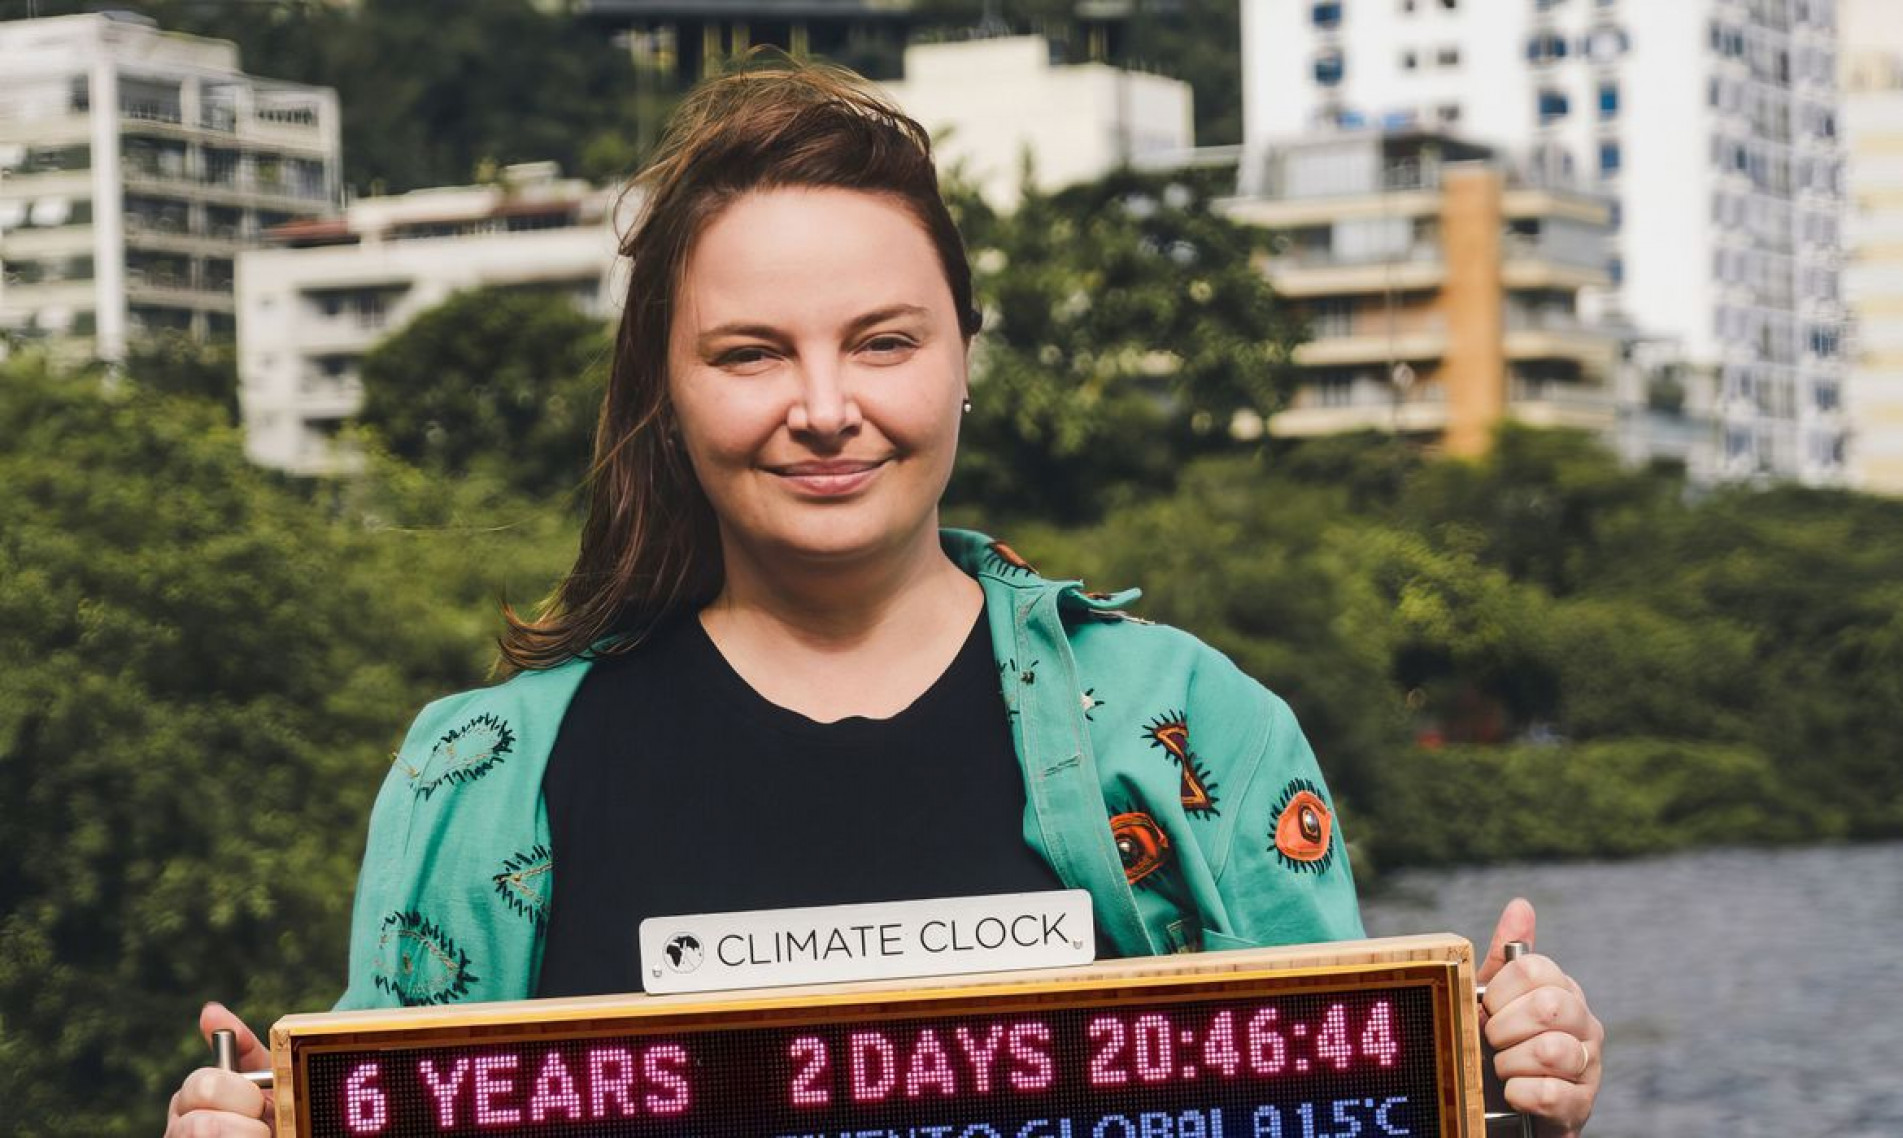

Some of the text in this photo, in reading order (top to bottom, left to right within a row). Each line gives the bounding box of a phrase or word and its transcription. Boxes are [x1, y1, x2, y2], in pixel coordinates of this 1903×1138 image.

[717, 912, 1070, 967] CLIMATE CLOCK
[346, 1001, 1398, 1133] 6 YEARS 2 DAYS 20:46:44
